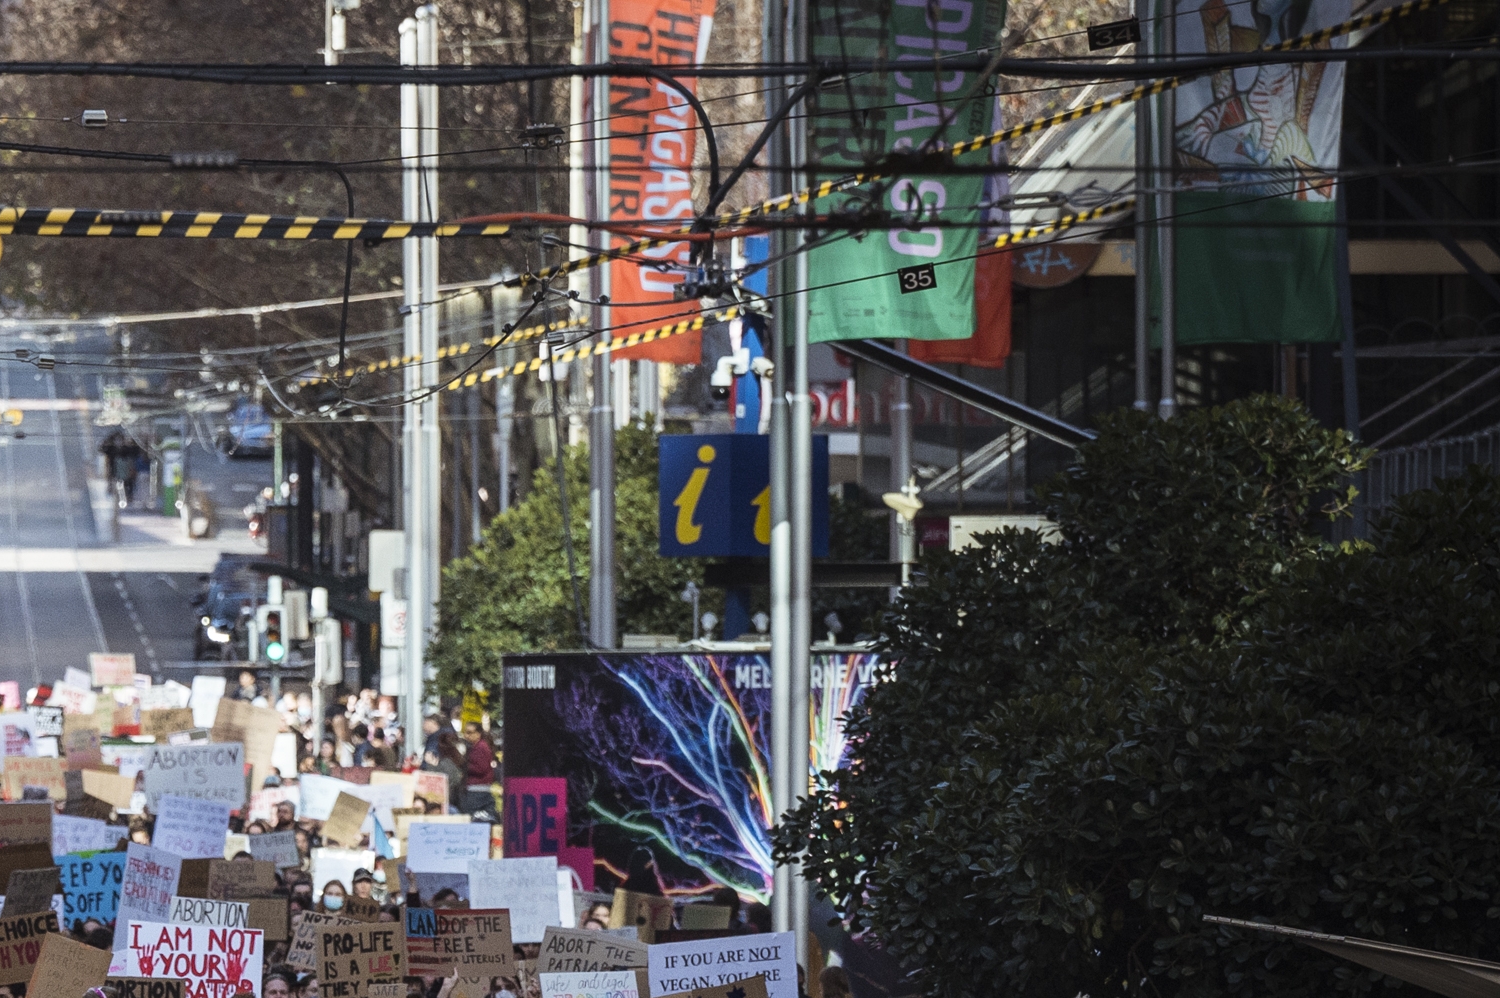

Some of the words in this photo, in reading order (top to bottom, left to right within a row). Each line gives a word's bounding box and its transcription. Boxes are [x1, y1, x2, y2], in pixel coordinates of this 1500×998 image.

[1096, 23, 1132, 48] 34
[903, 269, 932, 290] 35
[172, 898, 250, 927] ABORTION
[475, 916, 502, 933] THE
[158, 927, 193, 952] AM
[208, 929, 262, 954] NOT
[323, 931, 393, 956] PRO-LIFE
[547, 935, 596, 955] ABORT
[607, 946, 635, 962] THE
[159, 954, 226, 977] YOUR
[664, 956, 678, 970] IF
[681, 953, 708, 968] YOU
[716, 951, 746, 964] ARE
[748, 946, 782, 962] NOT
